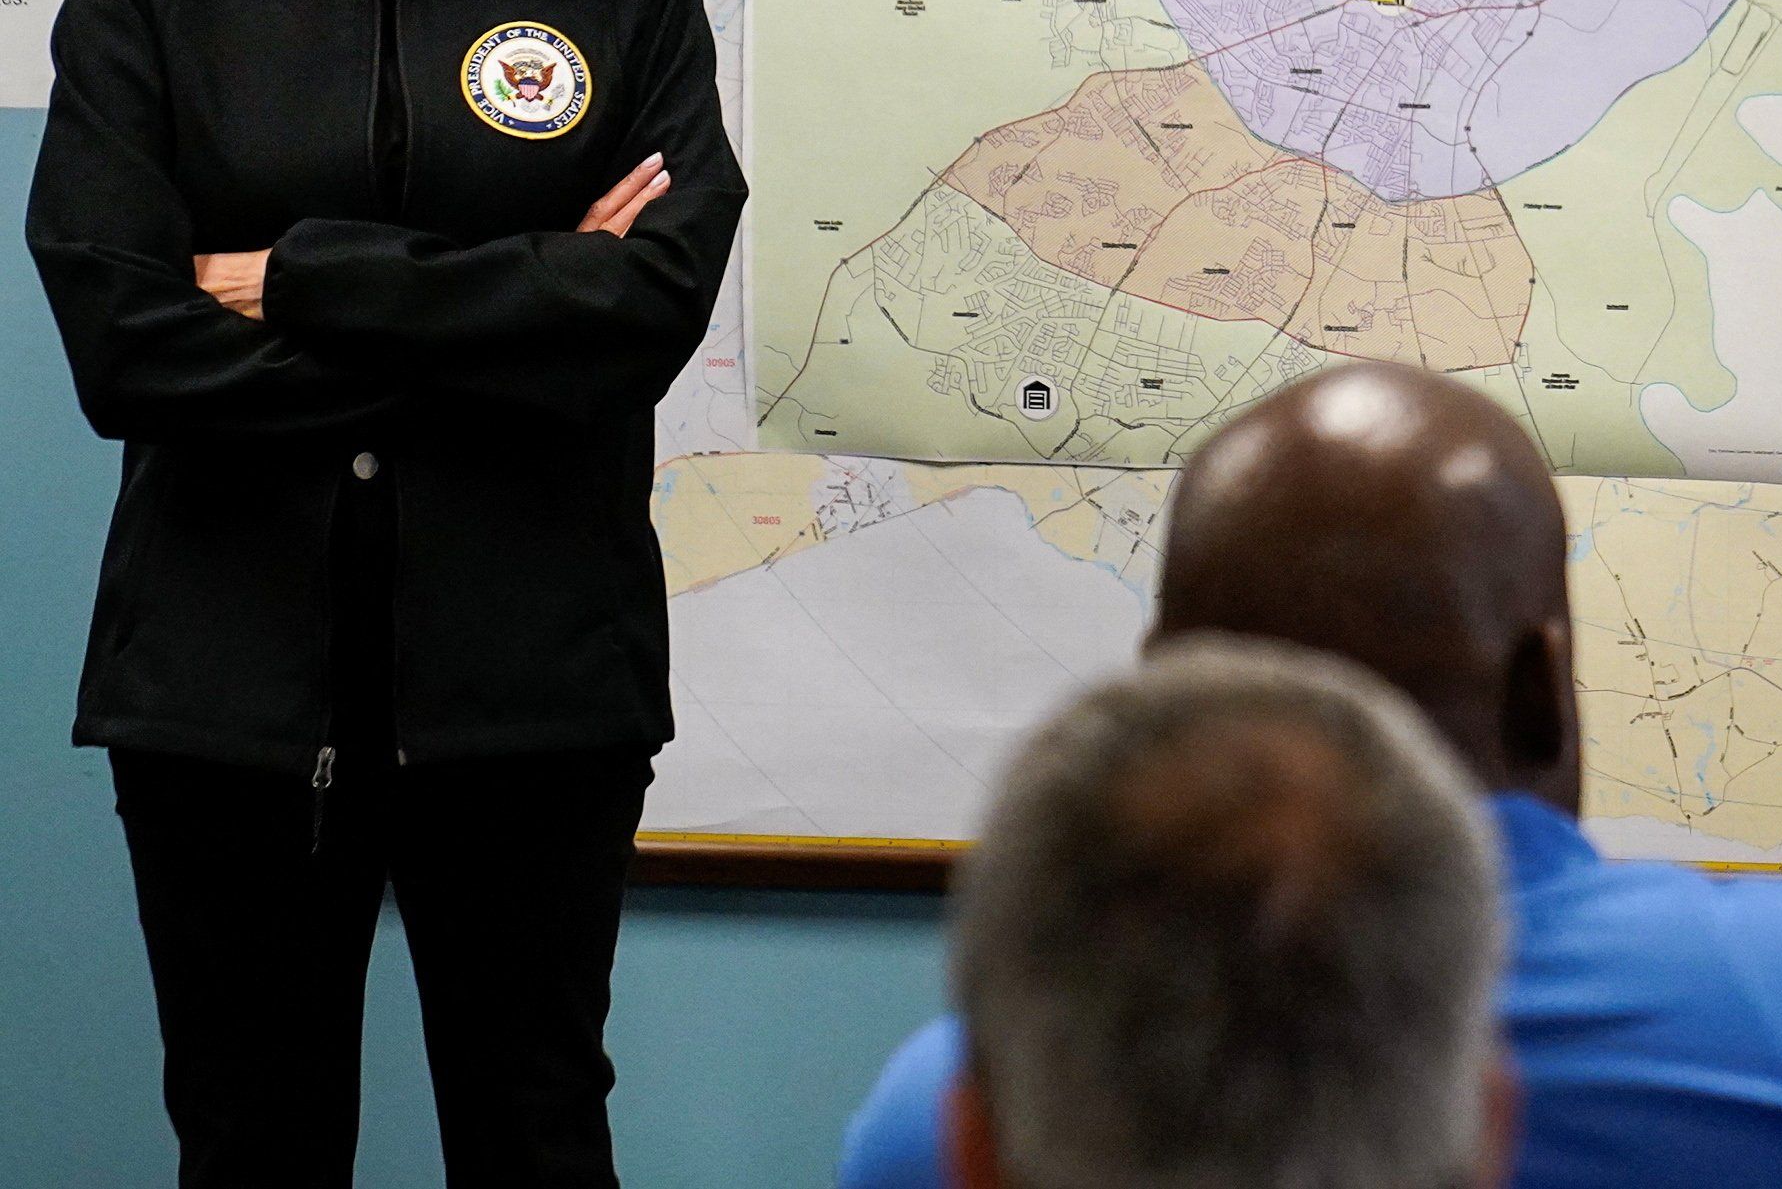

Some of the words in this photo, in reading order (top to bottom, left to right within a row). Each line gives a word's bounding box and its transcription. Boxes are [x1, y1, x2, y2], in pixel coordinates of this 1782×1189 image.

[507, 29, 522, 38] OF
[525, 29, 548, 41] THE
[468, 34, 501, 95] PRESIDENT
[553, 38, 585, 82] UNITED
[478, 98, 505, 124] VICE
[555, 91, 585, 128] STATES
